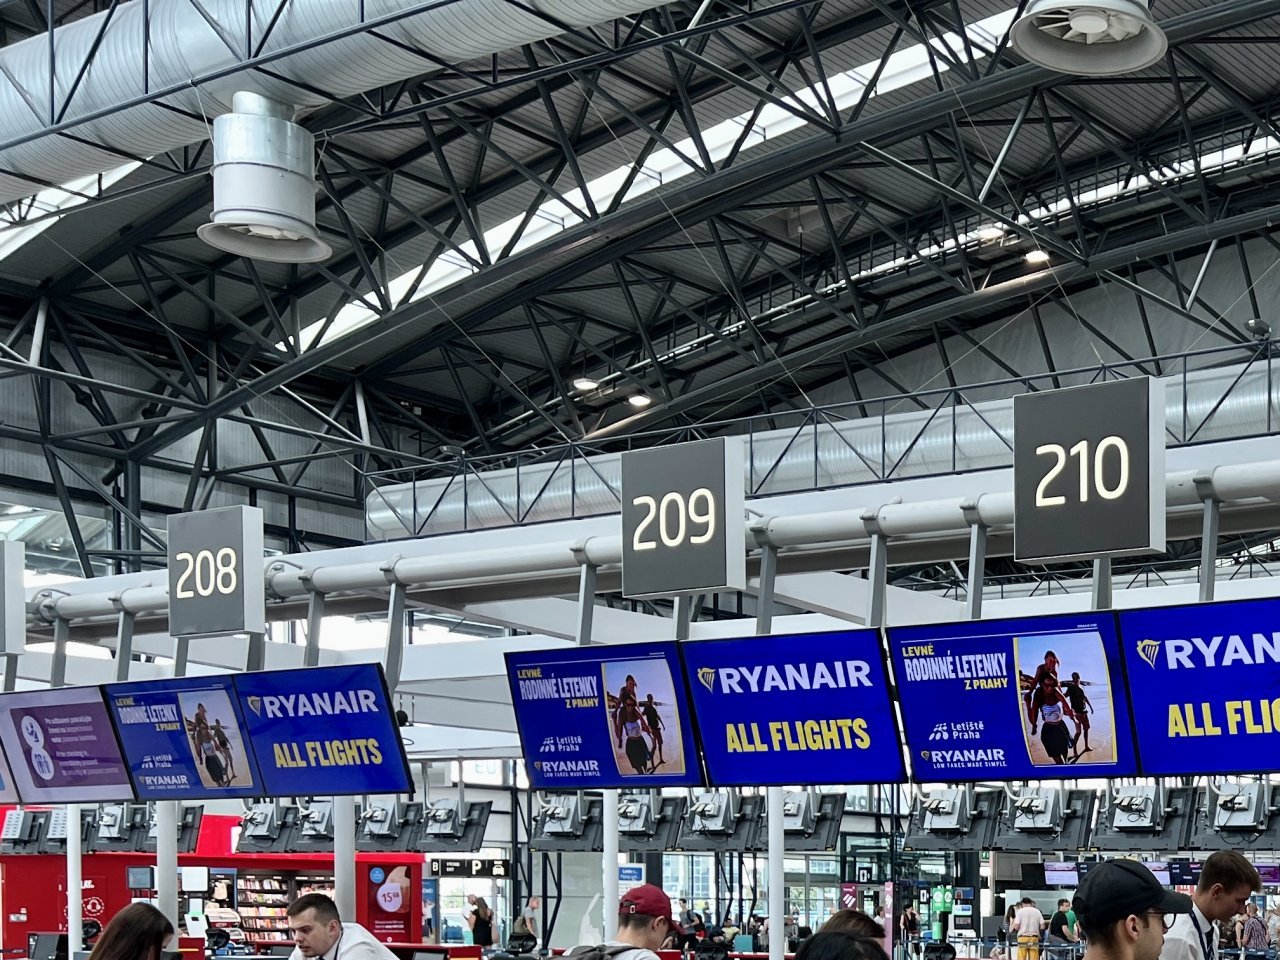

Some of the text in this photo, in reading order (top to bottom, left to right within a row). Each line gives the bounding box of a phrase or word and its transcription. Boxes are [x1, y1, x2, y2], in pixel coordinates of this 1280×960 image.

[1034, 435, 1130, 508] 210
[632, 486, 717, 552] 209
[176, 546, 237, 600] 208
[902, 642, 935, 657] LEVNÉ
[719, 660, 873, 695] RYANAIR
[904, 650, 1008, 682] RODINNÉ LETENKY
[519, 673, 598, 700] RODINNÉ LETENKY
[964, 678, 1009, 690] Z PRAHY
[263, 689, 379, 718] RYANAIR
[1168, 702, 1222, 738] ALL
[726, 717, 871, 753] ALL FLIGHTS
[953, 731, 981, 739] Praha
[273, 738, 383, 768] ALL FLIGHTS
[542, 760, 599, 772] RYANAIR
[931, 748, 1005, 762] RYANAIR
[145, 775, 188, 785] RYANAIR
[472, 860, 482, 875] P
